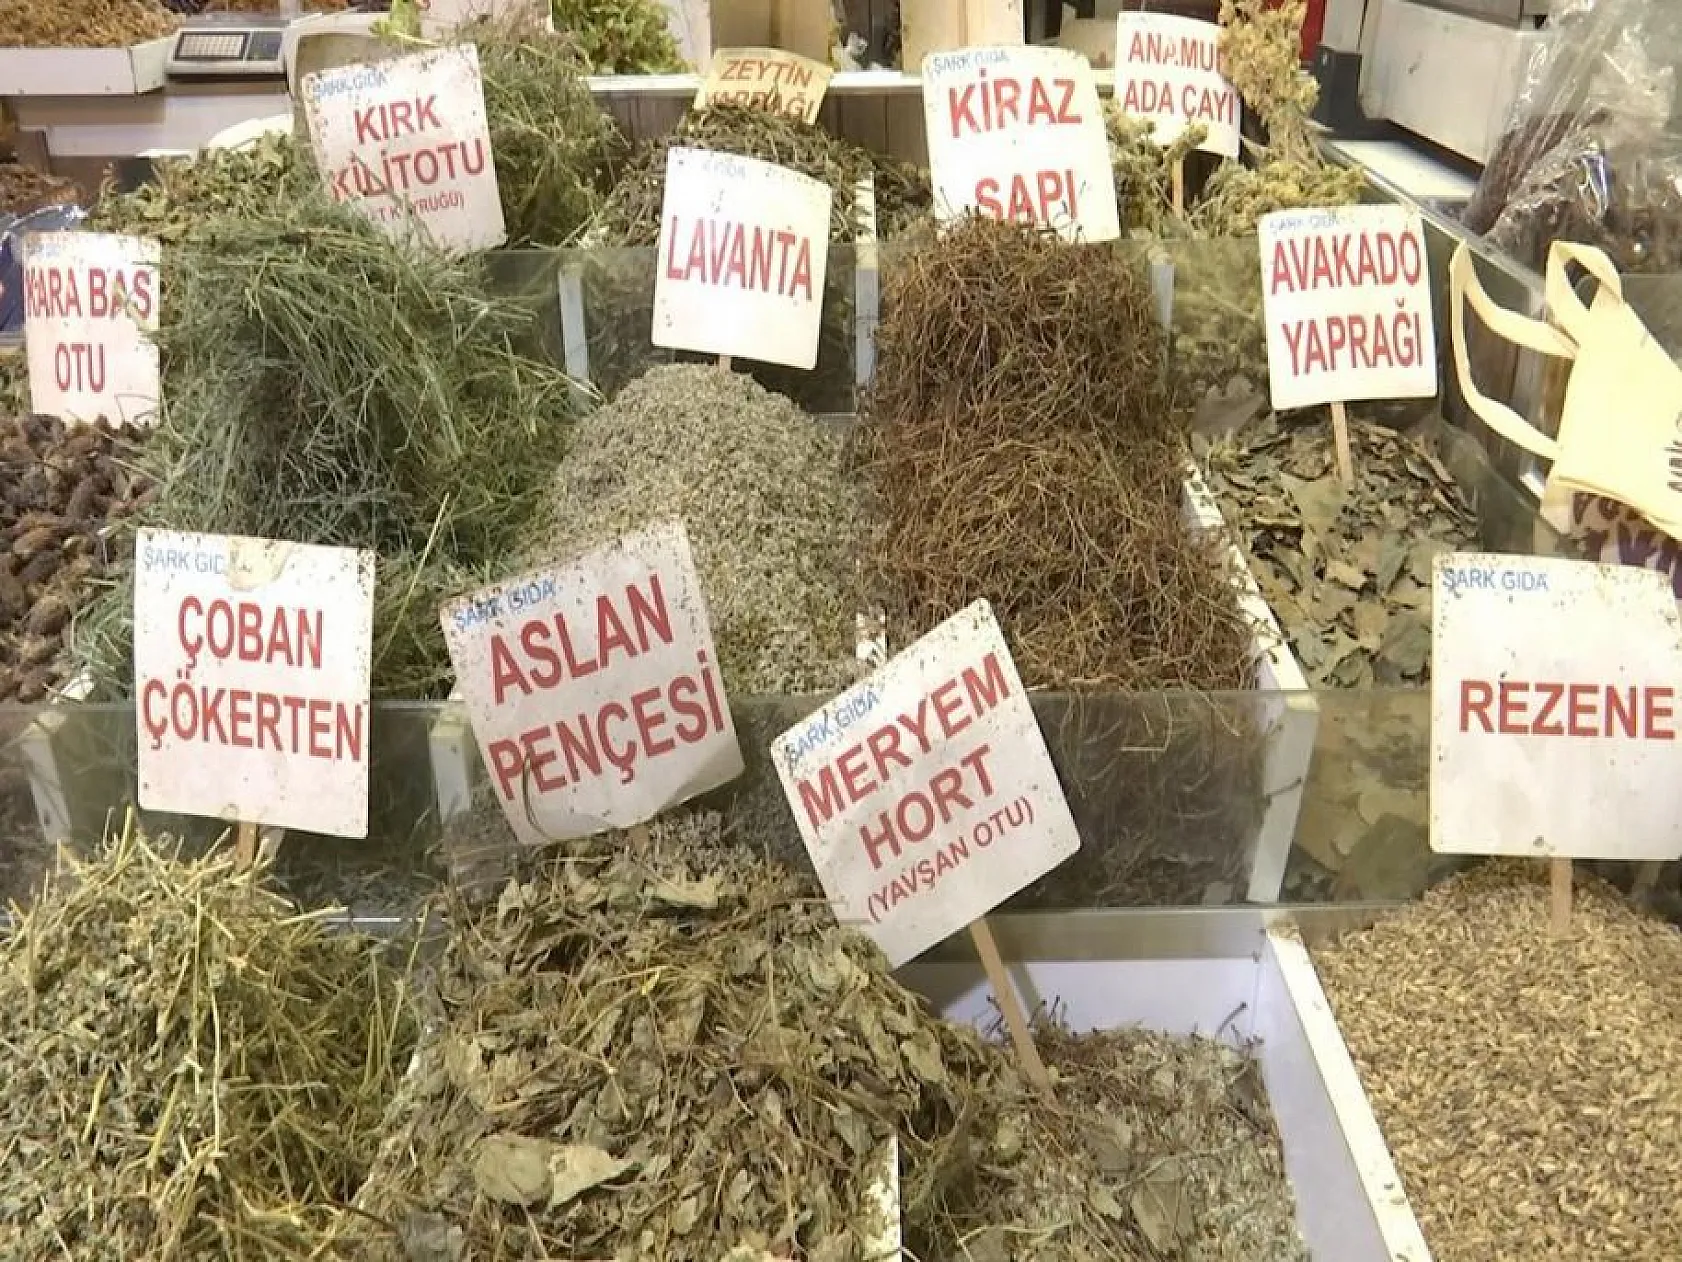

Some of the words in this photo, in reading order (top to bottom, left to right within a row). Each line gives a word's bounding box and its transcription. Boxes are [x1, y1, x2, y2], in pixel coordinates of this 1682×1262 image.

[720, 58, 813, 88] ZEYTİN
[949, 67, 1083, 139] KİRAZ
[1124, 79, 1175, 115] ADA
[1182, 84, 1234, 126] ÇAYI
[354, 93, 442, 145] KIRK
[975, 169, 1078, 228] SAPI
[666, 215, 813, 302] LAVANTA
[1271, 230, 1421, 295] AVAKADO
[55, 341, 105, 393] OTU
[1281, 298, 1423, 377] YAPRAĞI
[1501, 571, 1550, 592] GIDA
[178, 595, 324, 670] ÇOBAN
[490, 572, 674, 706] ASLAN
[143, 668, 364, 762] ÇÖKERTEN
[487, 649, 725, 801] PENÇESİ
[796, 651, 1011, 831] MERYEM
[1459, 679, 1677, 741] REZENE
[859, 743, 995, 870] HORT
[867, 836, 971, 923] (YAVŞAN
[972, 796, 1035, 848] OTU)
